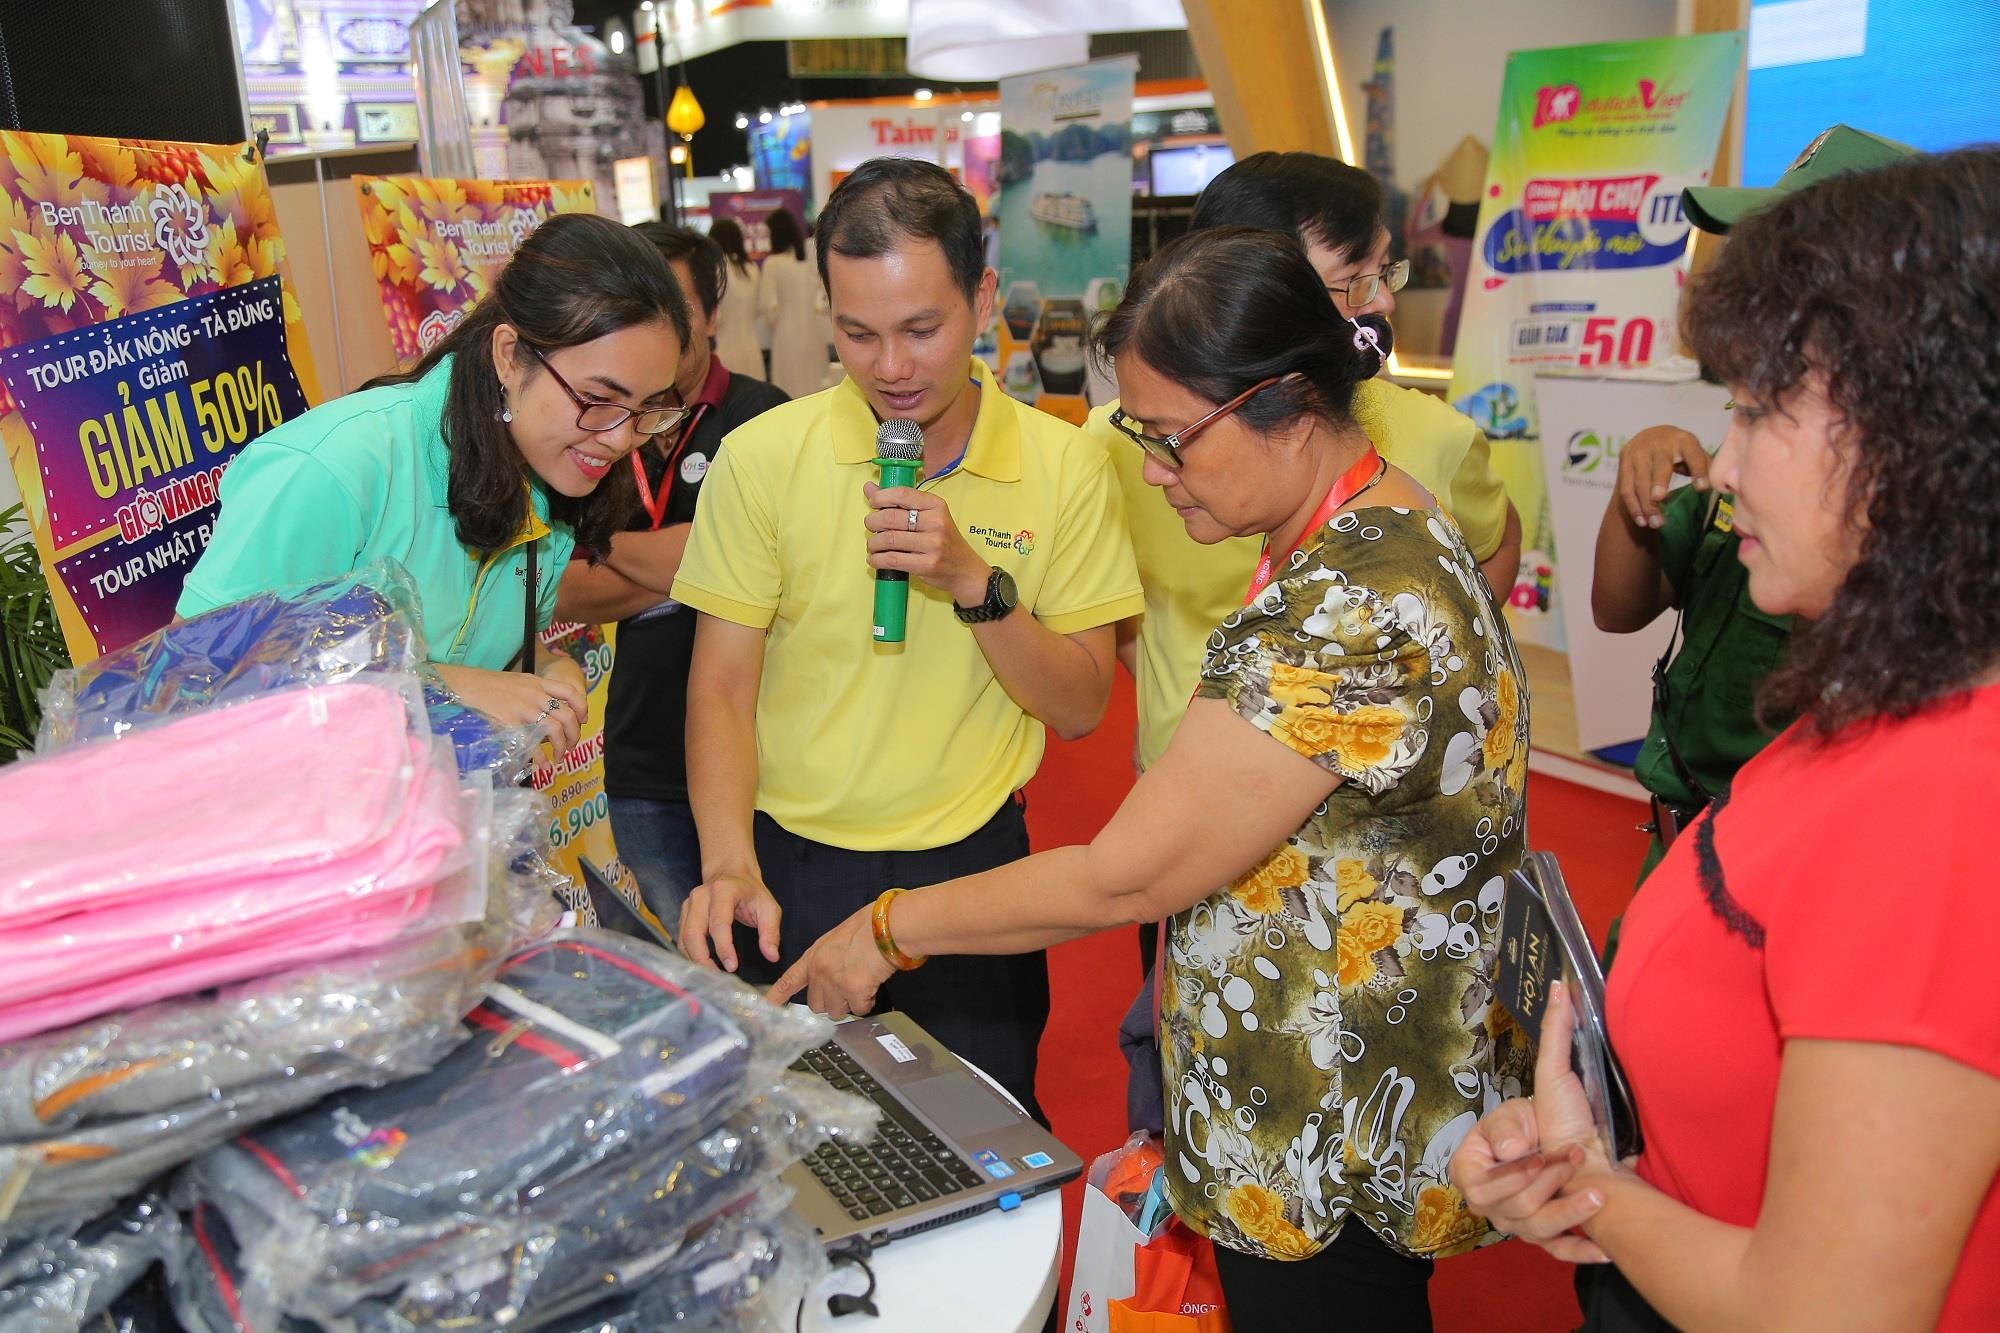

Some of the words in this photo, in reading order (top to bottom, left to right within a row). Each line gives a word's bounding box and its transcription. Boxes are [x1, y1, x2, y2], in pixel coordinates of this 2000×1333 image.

[85, 229, 153, 254] Tourist
[464, 239, 512, 256] Tourist
[109, 258, 118, 268] to
[118, 258, 136, 270] your
[137, 256, 157, 267] heart
[27, 355, 89, 392] TOUR
[89, 331, 137, 373] ĐẮK
[134, 324, 191, 360] NÔNG
[200, 308, 228, 340] TÀ
[227, 299, 274, 331] ĐÙNG
[139, 358, 190, 390] Giảm
[78, 381, 195, 498] GIẢM
[190, 360, 283, 453] 50%
[156, 478, 216, 524] VÀNG
[969, 525, 987, 535] Ben
[988, 528, 1012, 540] Thanh
[985, 537, 1011, 549] Tourist
[90, 556, 148, 600] TOUR
[146, 530, 197, 565] NHẬT
[563, 740, 594, 773] THỤY
[1527, 932, 1541, 971] AN
[1522, 971, 1536, 1017] HỘI
